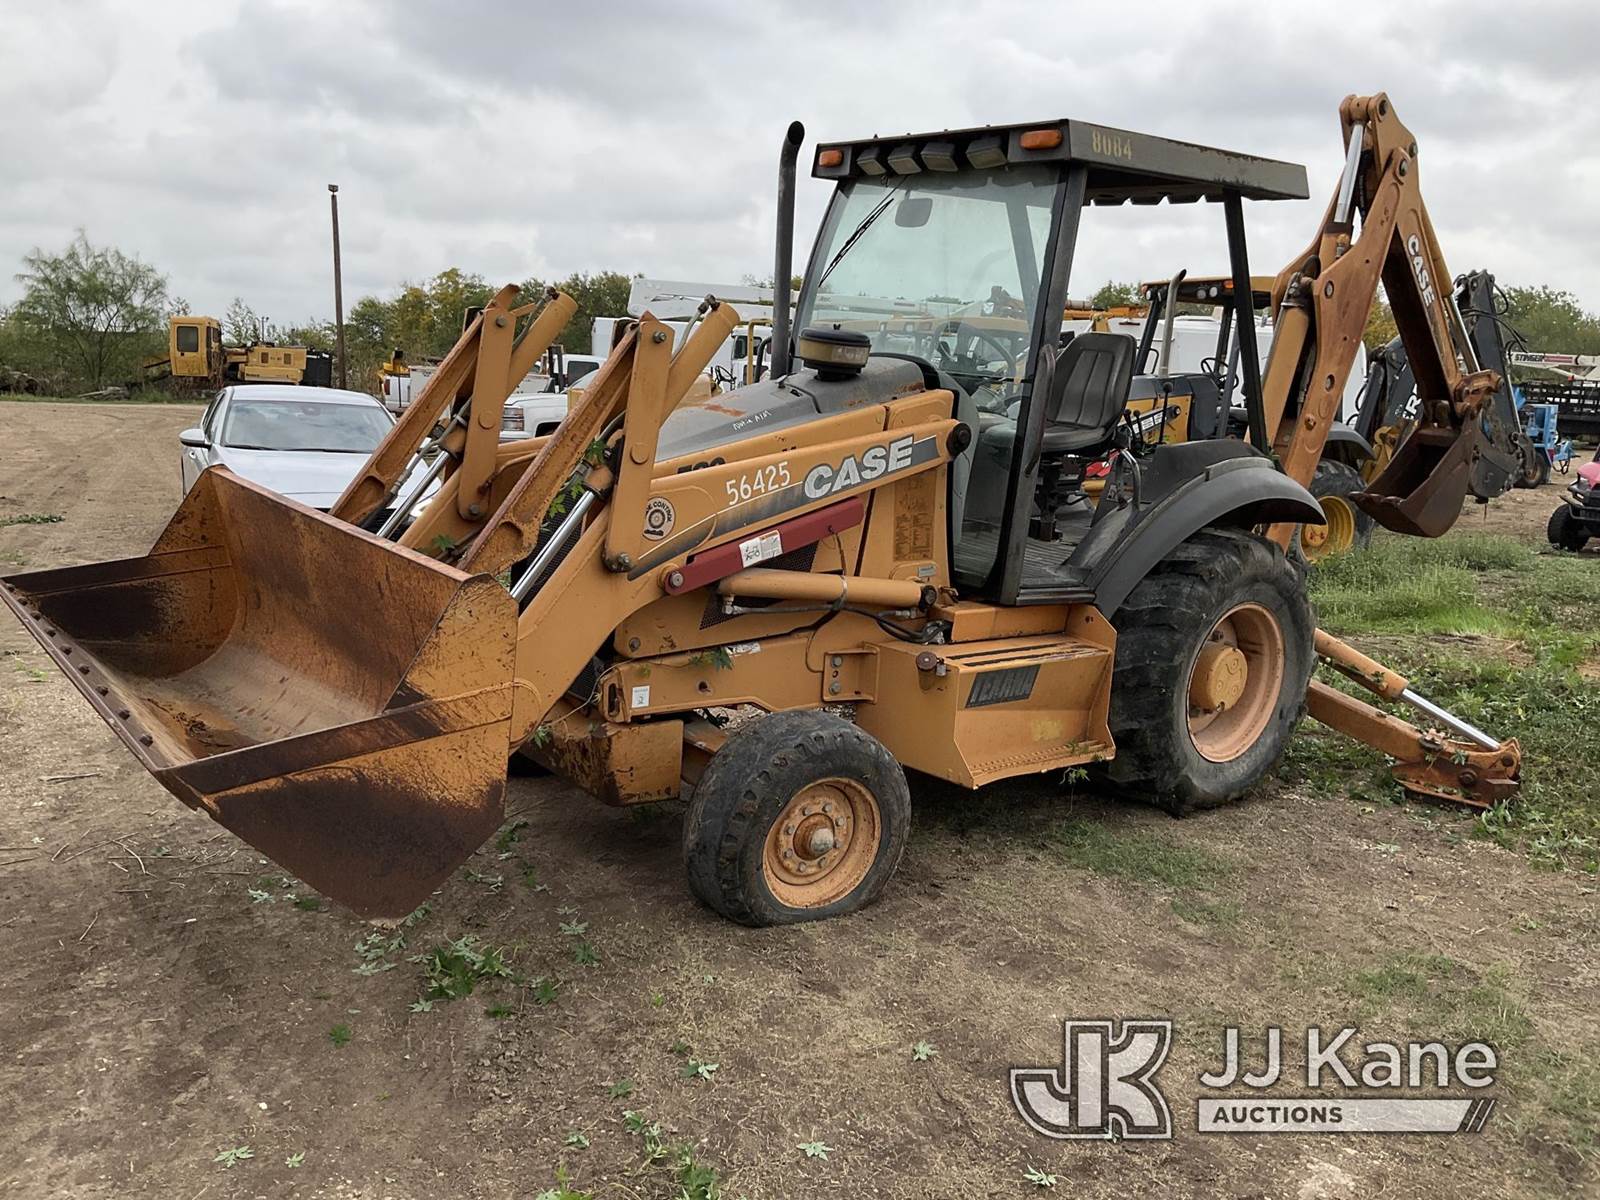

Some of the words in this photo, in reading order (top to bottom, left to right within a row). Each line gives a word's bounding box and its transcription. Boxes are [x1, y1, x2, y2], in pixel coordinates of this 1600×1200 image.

[1092, 129, 1132, 160] 8084
[1407, 234, 1435, 307] CASE
[726, 461, 791, 505] 56425
[804, 435, 914, 499] CASE
